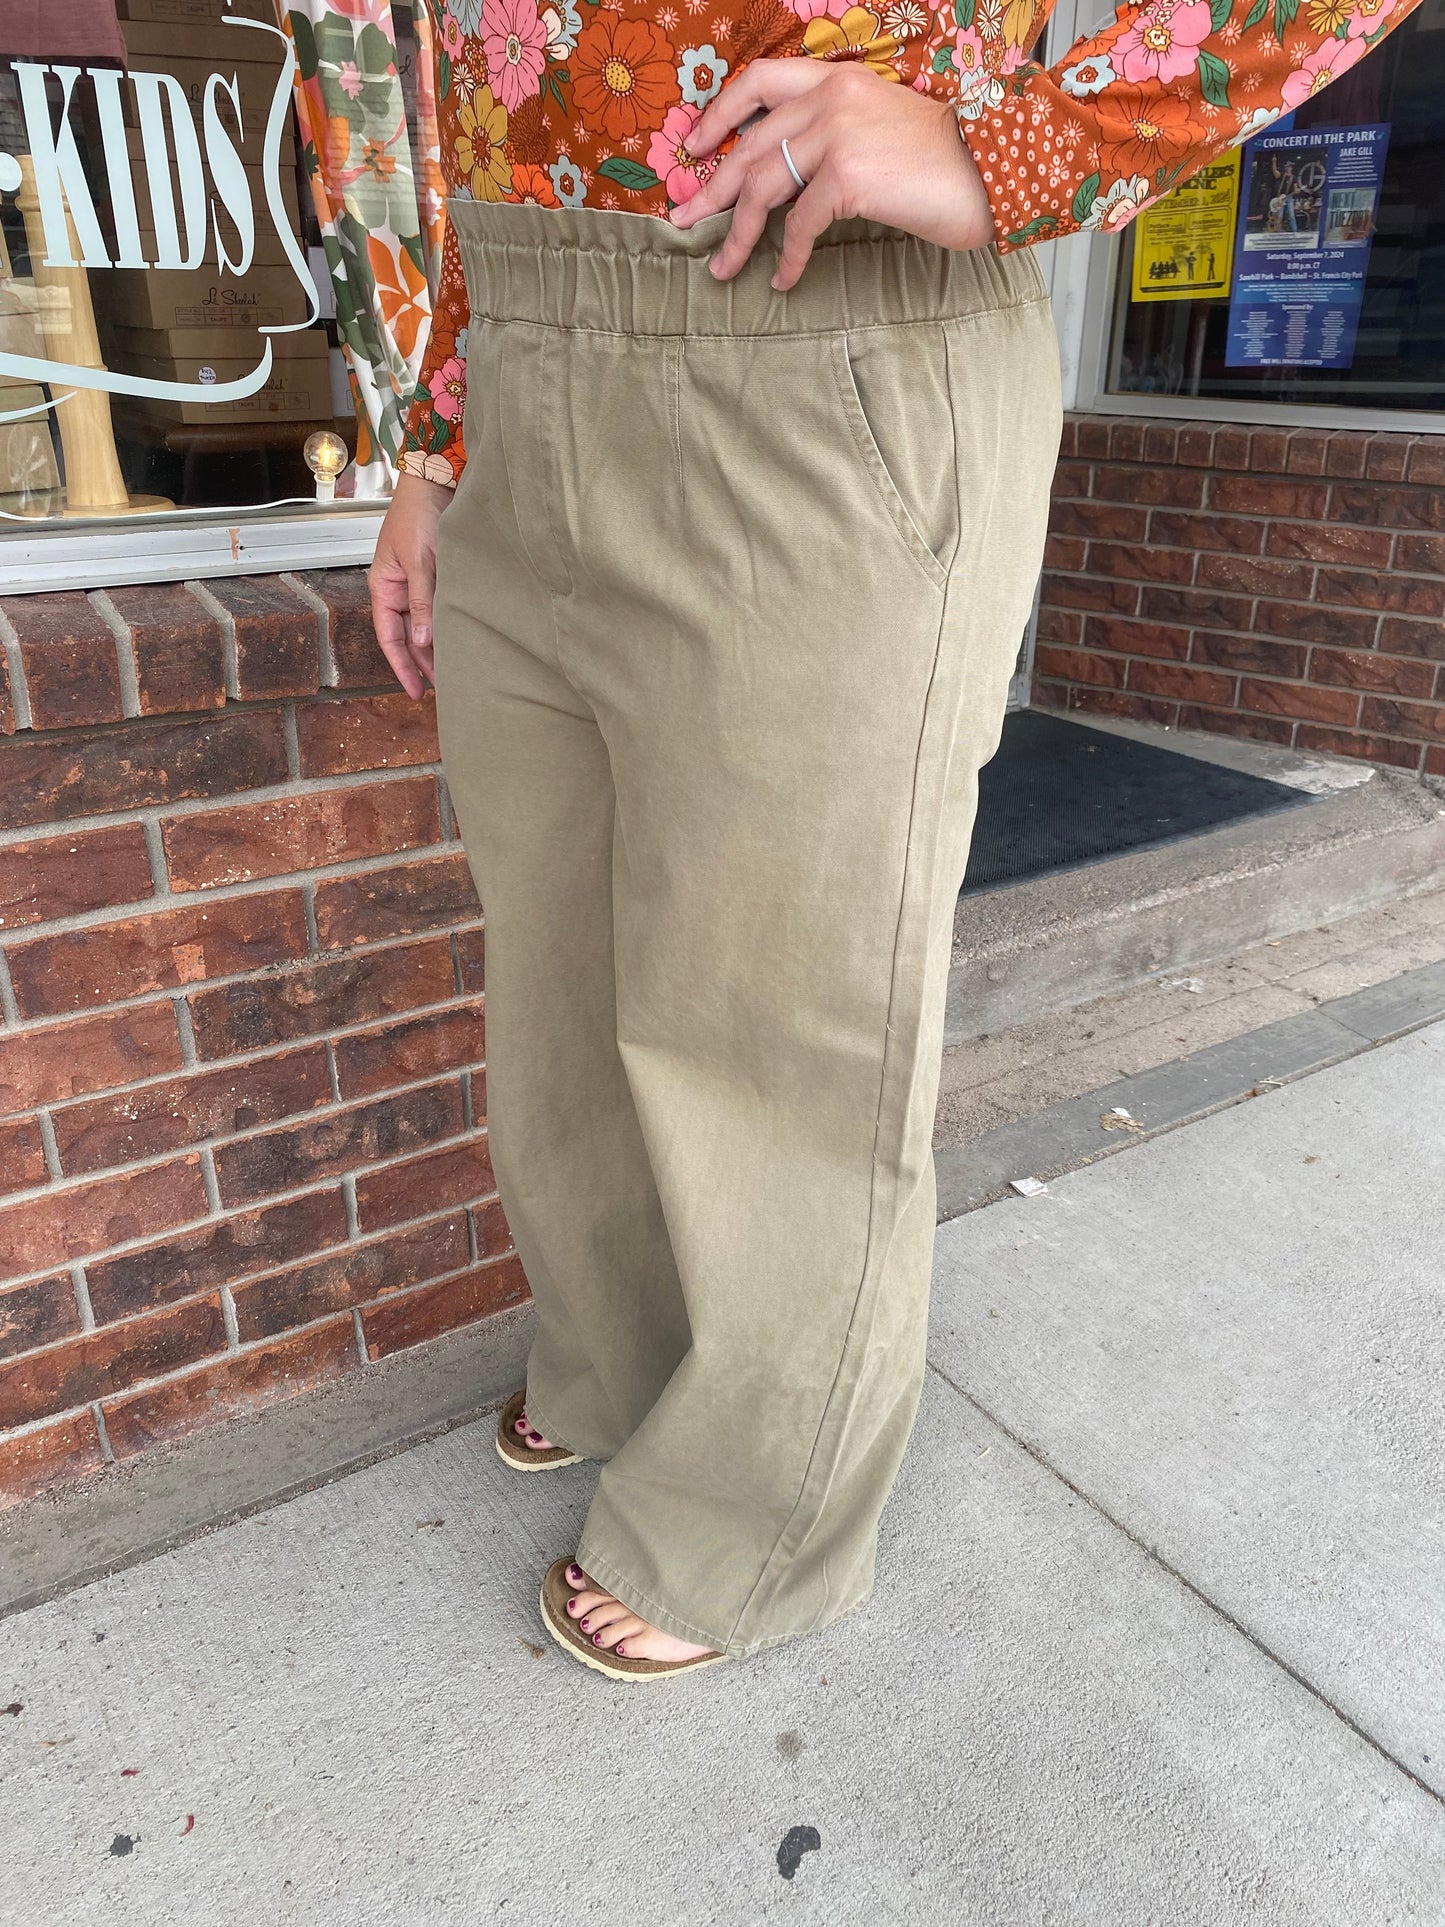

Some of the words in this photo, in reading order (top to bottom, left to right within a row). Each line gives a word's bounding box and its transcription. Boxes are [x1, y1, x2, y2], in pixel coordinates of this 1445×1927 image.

[1263, 135, 1309, 148] CONCERT
[1310, 134, 1322, 145] IN
[1324, 132, 1345, 144] THE
[1347, 130, 1377, 142] PARK
[1339, 147, 1357, 157] JAKE
[1357, 146, 1373, 156] GILL
[10, 62, 255, 277] KIDS
[1266, 252, 1292, 261] Saturday,
[1293, 251, 1324, 260] September
